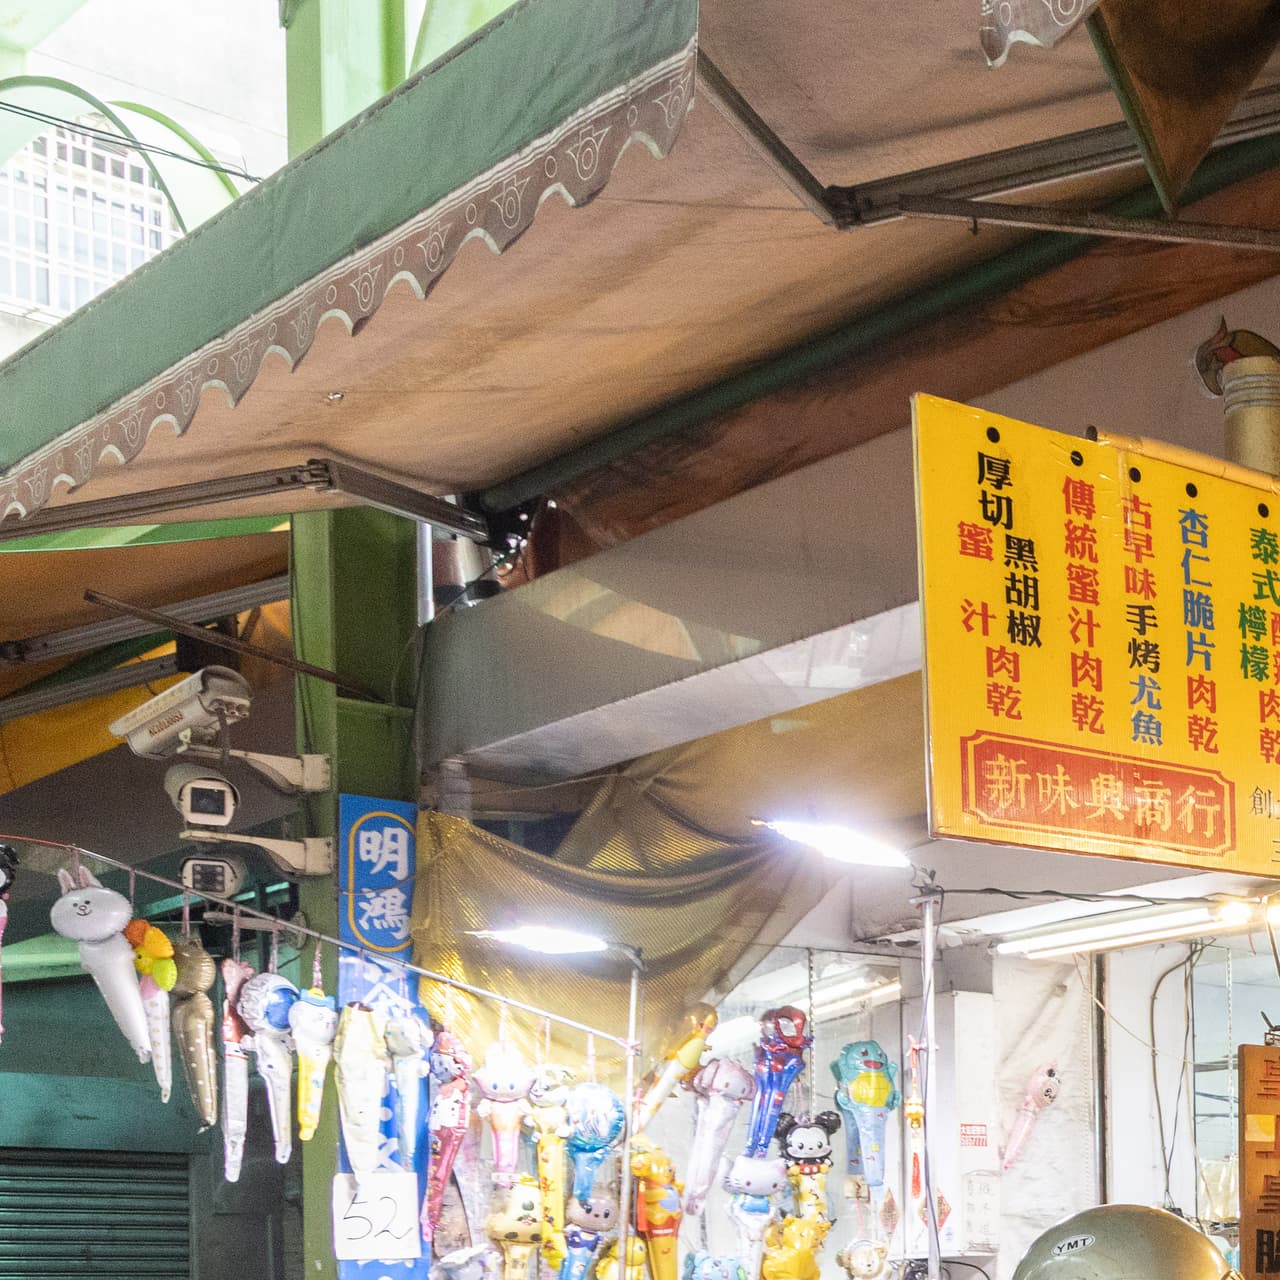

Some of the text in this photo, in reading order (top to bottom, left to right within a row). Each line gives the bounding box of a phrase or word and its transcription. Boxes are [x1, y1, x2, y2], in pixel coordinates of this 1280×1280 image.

[977, 450, 1015, 530] 厚切
[956, 519, 996, 637] 蜜汁
[1003, 532, 1043, 648] 黑胡椒
[1061, 473, 1106, 736] 傳統蜜汁肉乾
[1119, 493, 1165, 748] 古早味手烤尤魚
[1177, 506, 1220, 756] 杏仁脆片肉乾
[1236, 602, 1271, 682] 檸檬
[984, 644, 1023, 723] 肉乾
[983, 750, 1222, 840] 新味興商行
[342, 1191, 415, 1243] 52
[1056, 1236, 1090, 1255] YMT
